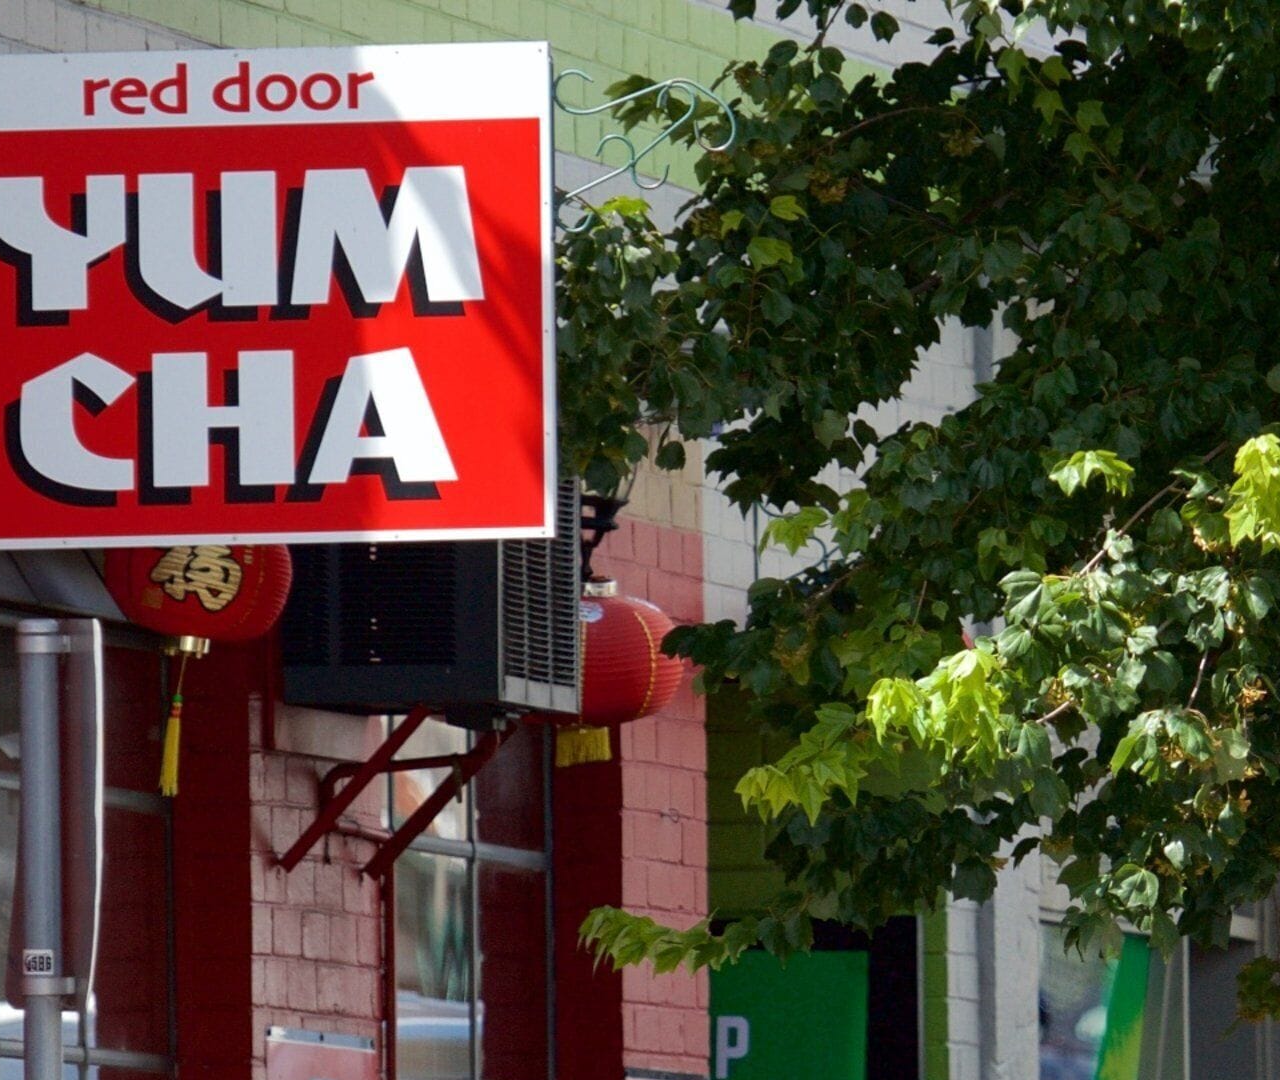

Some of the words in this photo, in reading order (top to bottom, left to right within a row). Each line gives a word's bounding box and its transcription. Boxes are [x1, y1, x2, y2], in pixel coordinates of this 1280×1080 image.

[83, 62, 188, 116] red
[211, 61, 375, 113] door
[12, 346, 460, 498] CHA
